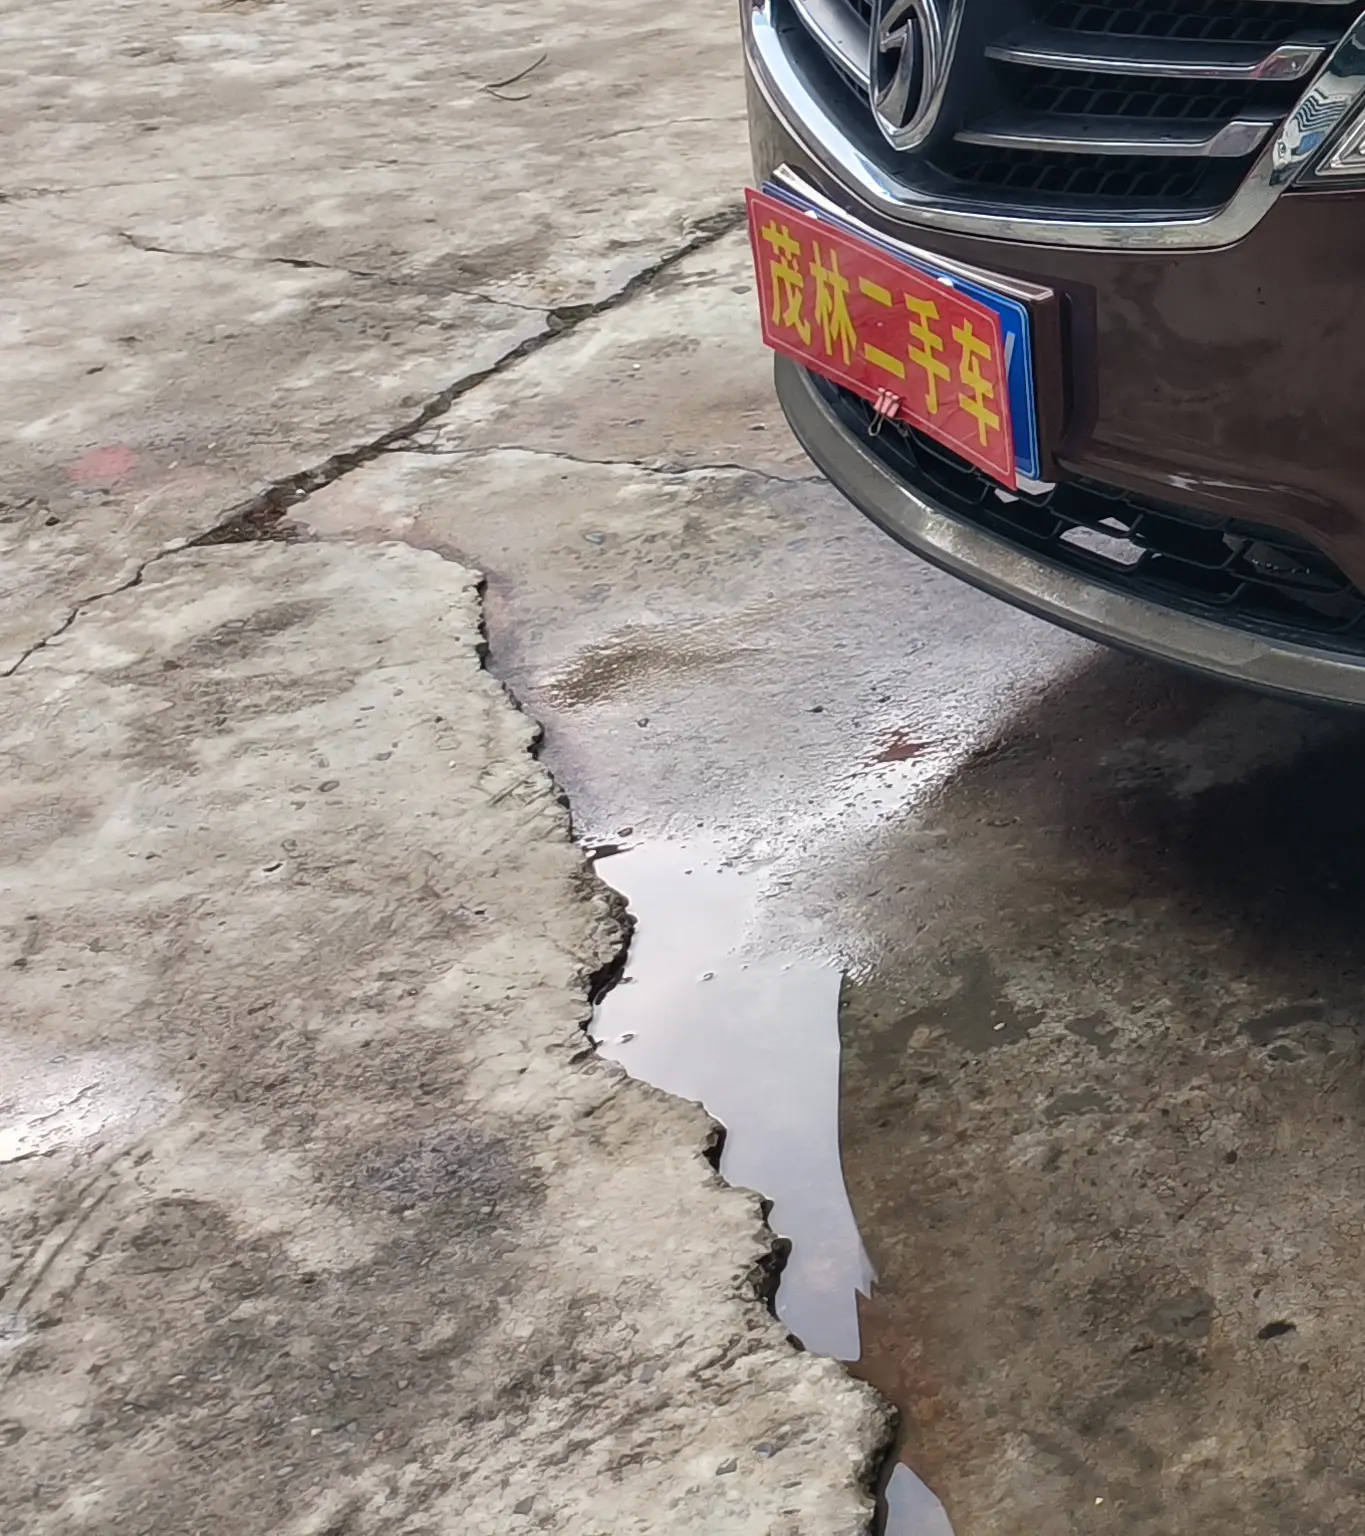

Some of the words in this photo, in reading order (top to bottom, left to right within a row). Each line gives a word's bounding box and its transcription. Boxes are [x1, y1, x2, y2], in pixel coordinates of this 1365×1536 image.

[760, 218, 1000, 448] 茂林二手车
